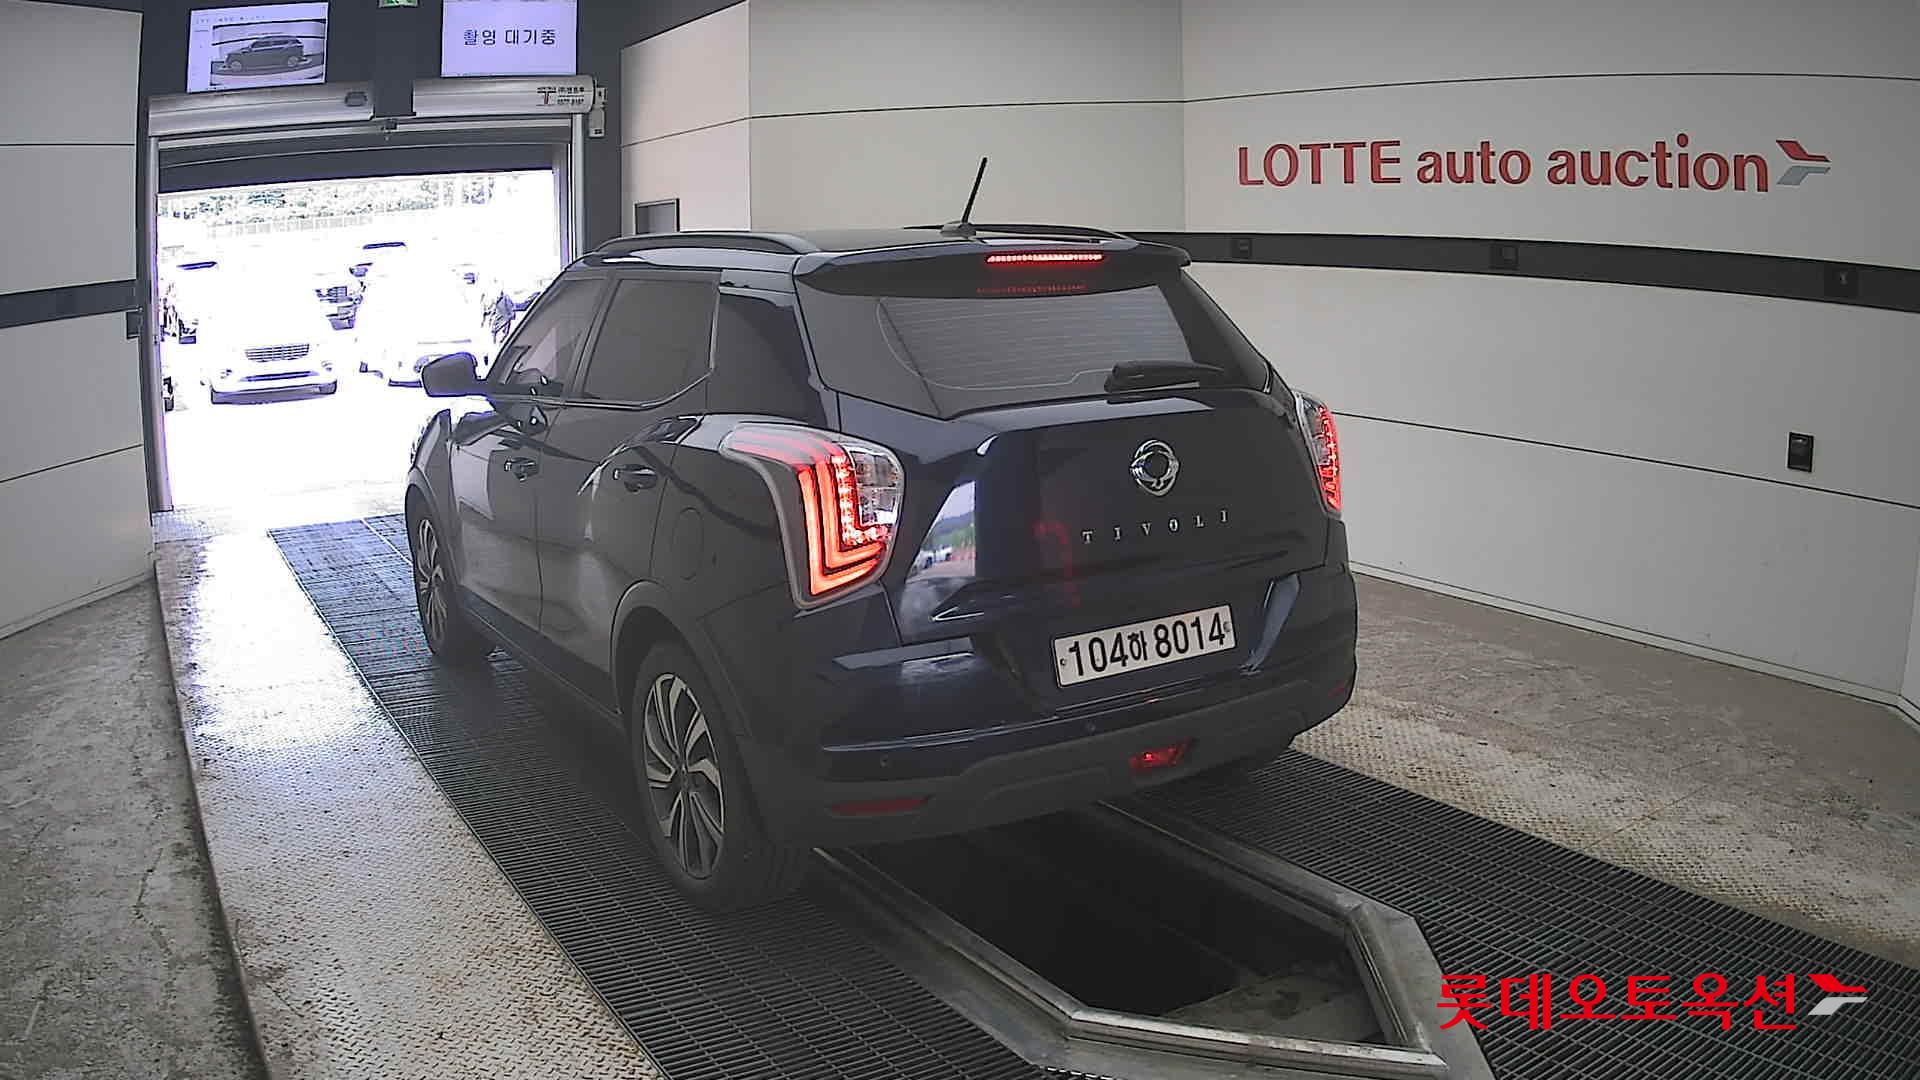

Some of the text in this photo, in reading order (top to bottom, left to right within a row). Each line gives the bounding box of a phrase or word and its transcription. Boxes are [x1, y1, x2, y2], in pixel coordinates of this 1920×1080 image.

[463, 29, 556, 46] 촬영 대기중
[1239, 133, 1769, 193] LOTTE auto auction
[1082, 509, 1229, 544] TIVOLI
